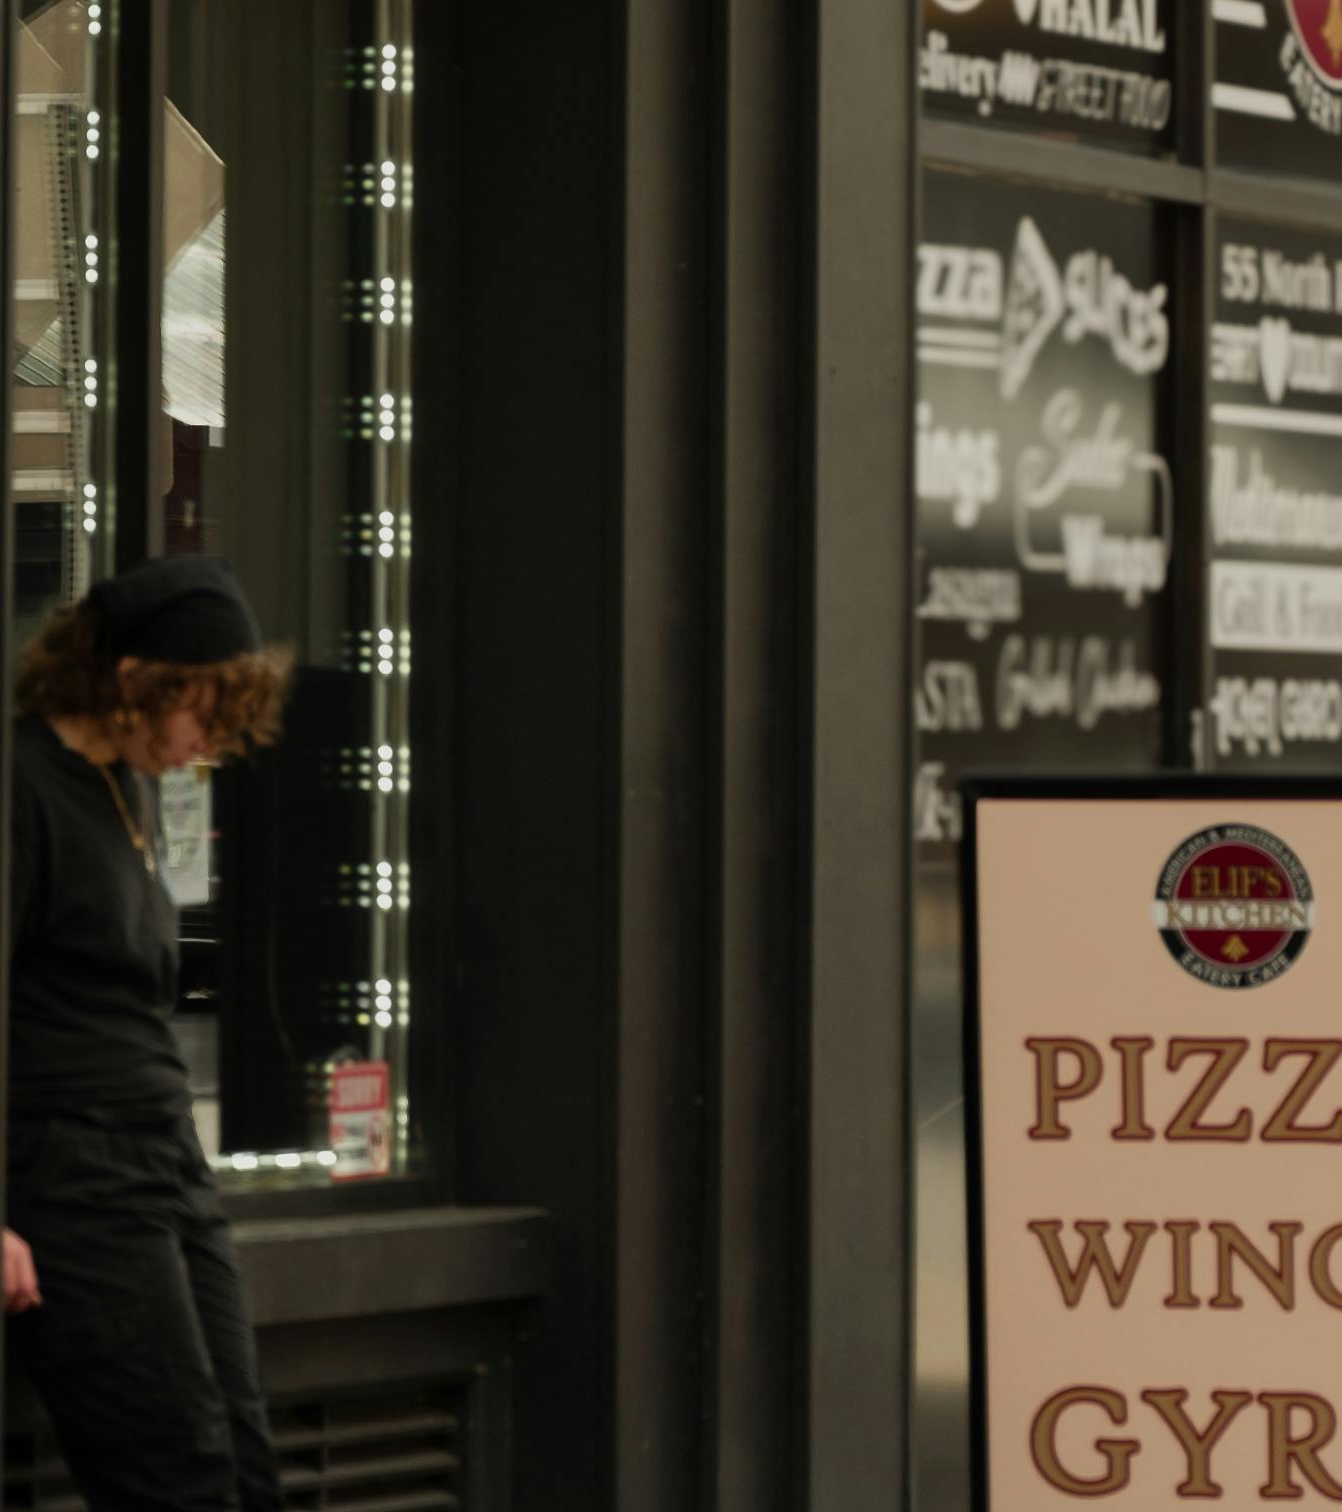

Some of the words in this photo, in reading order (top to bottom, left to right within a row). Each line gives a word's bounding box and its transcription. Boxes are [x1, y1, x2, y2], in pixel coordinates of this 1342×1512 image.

[1221, 242, 1259, 304] 55
[1261, 249, 1333, 314] North
[1191, 864, 1284, 899] ELIF'S
[1166, 899, 1310, 930] KITCHEN
[1180, 950, 1245, 988] EATERY
[1247, 953, 1290, 985] CAFE
